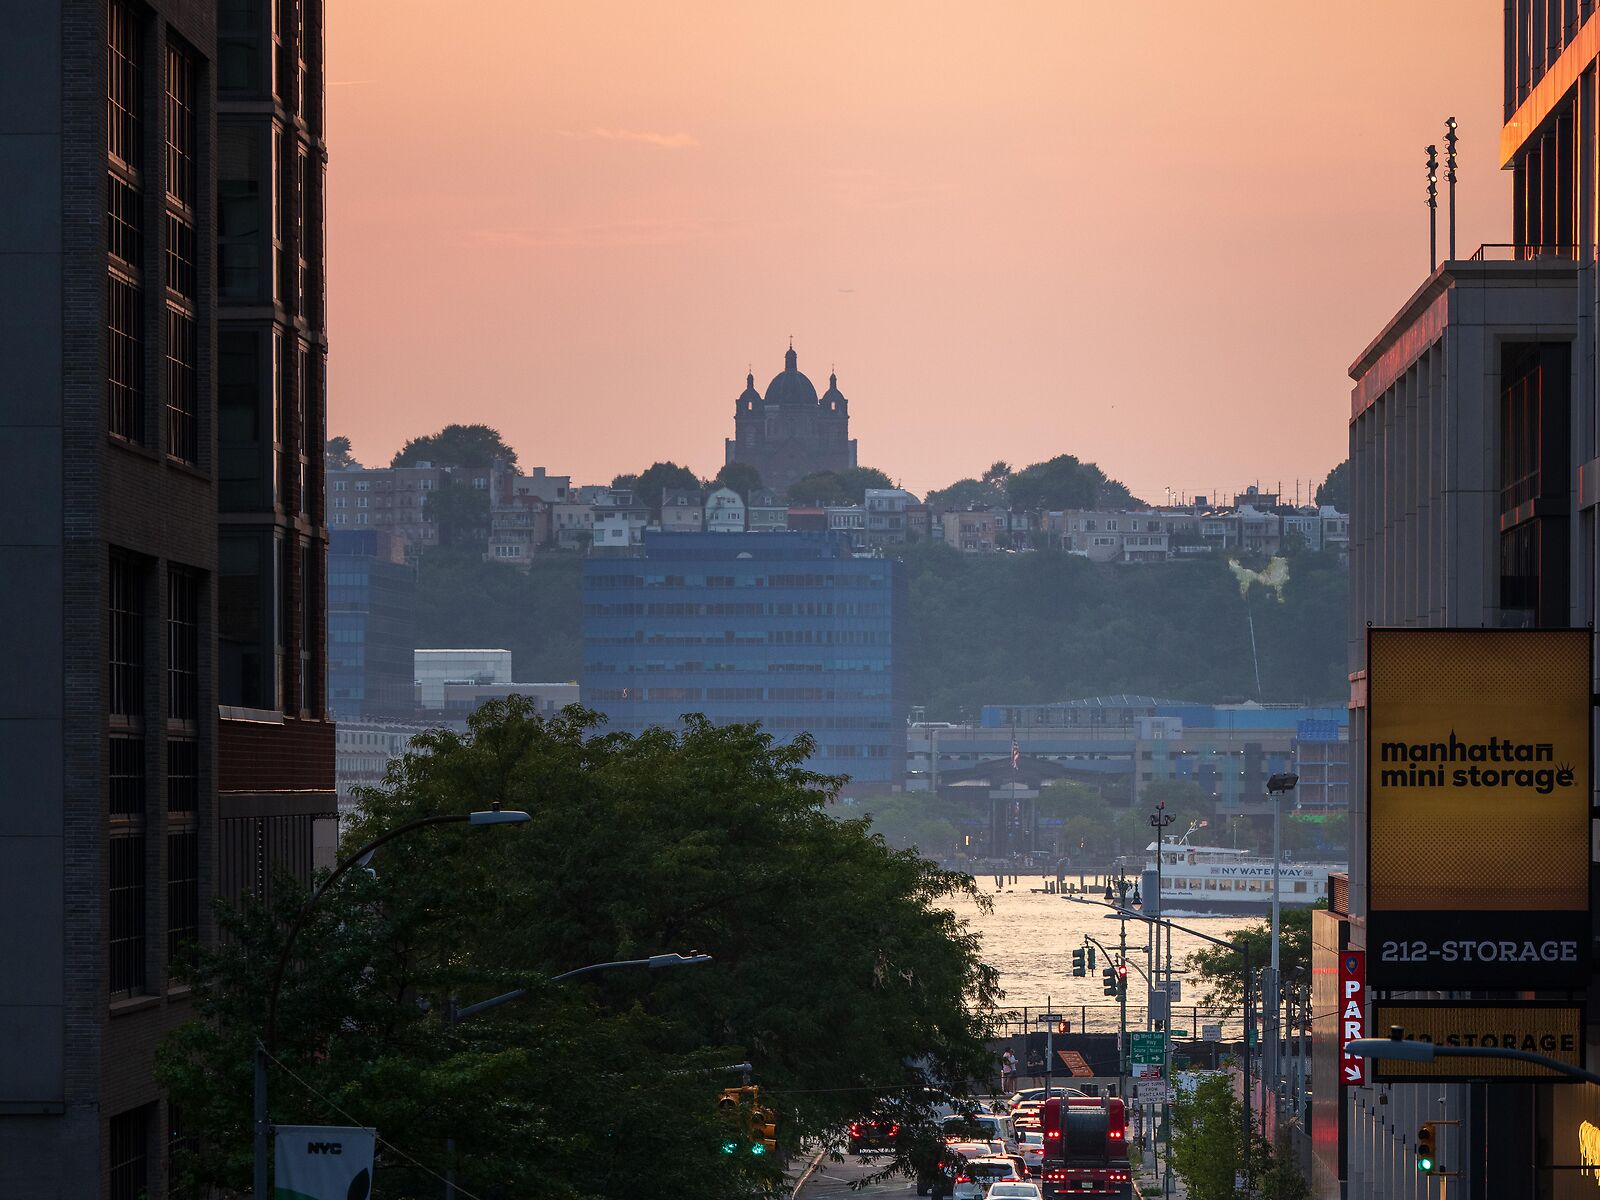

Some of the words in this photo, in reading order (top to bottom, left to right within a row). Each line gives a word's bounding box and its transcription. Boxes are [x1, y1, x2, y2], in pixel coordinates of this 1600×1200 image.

[1381, 728, 1553, 762] manhattan
[1381, 763, 1445, 787] mini
[1452, 762, 1575, 794] storage
[1381, 941, 1577, 962] 212-STORAGE
[308, 1142, 342, 1155] NYC
